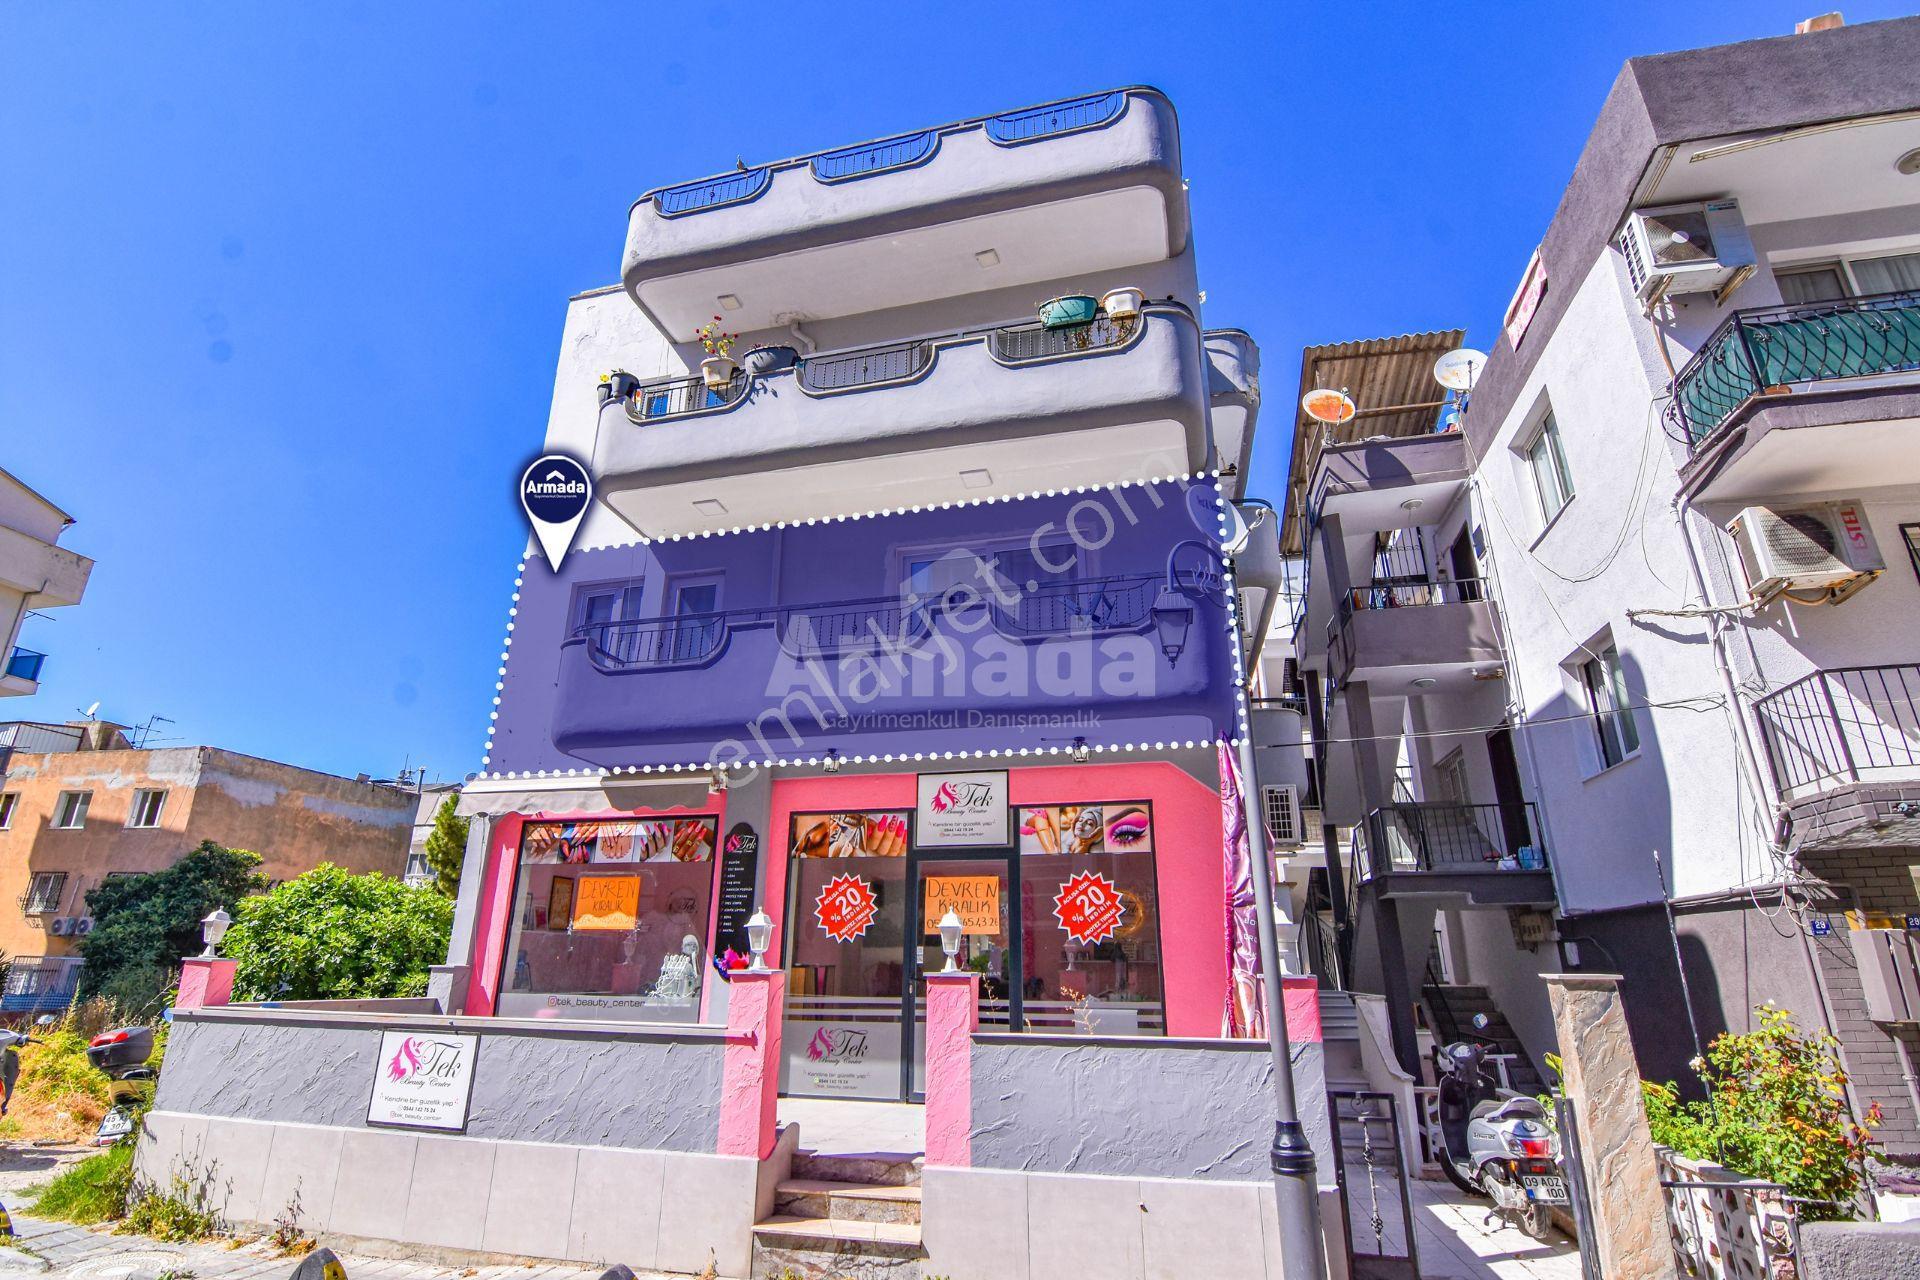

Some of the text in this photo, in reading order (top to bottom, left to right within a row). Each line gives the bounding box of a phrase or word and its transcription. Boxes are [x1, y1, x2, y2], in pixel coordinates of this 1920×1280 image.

[956, 781, 993, 808] Tek
[581, 879, 637, 900] DEVREN
[928, 878, 998, 898] DEVREN
[835, 887, 861, 917] 20
[1076, 885, 1105, 917] 20
[1083, 920, 1102, 937] PROTEZ
[830, 1027, 869, 1058] Tek
[416, 1039, 464, 1078] Tek
[400, 1076, 452, 1089] Beauty Center
[1524, 1176, 1539, 1187] 09
[1546, 1188, 1565, 1199] 100
